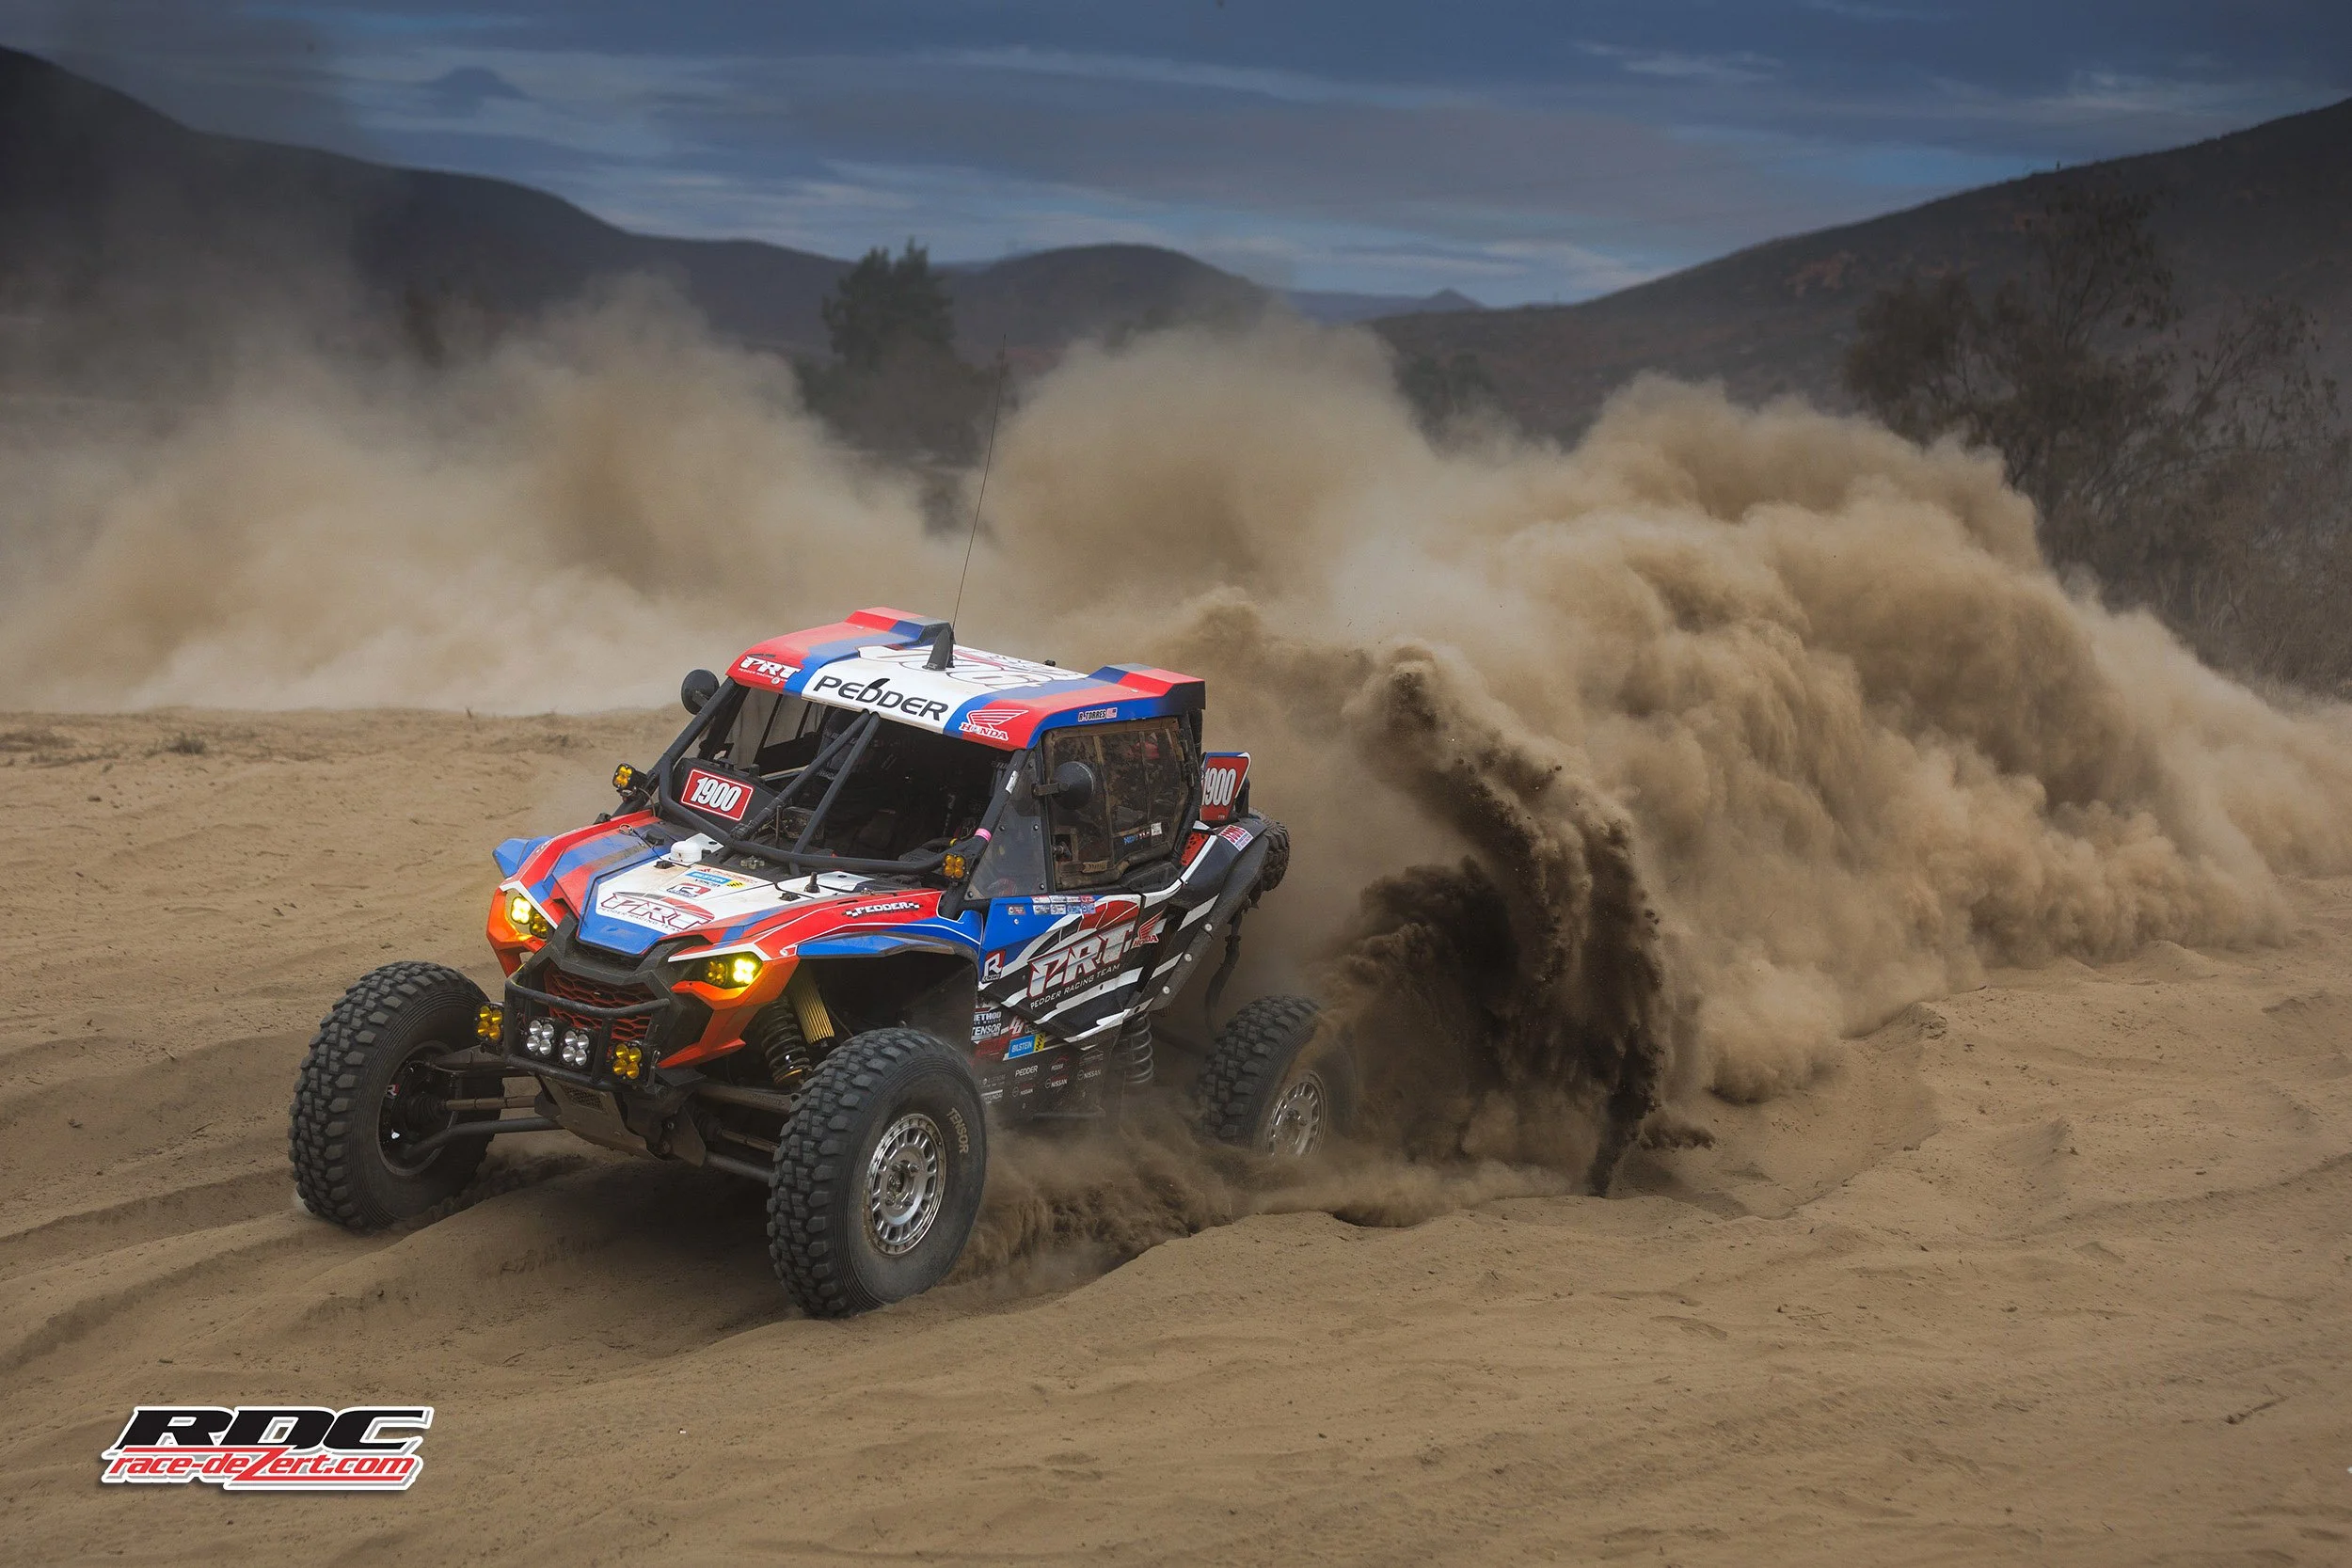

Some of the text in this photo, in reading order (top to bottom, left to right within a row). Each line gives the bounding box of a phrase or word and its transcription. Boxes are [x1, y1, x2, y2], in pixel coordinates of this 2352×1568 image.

[739, 656, 803, 679] PRT
[813, 675, 948, 721] PEDDER
[960, 722, 1009, 740] HONDA
[691, 777, 742, 812] 1900
[1202, 768, 1237, 806] 1900
[600, 893, 712, 930] PRT
[854, 901, 911, 915] PEDDER
[1026, 920, 1136, 998] PRT
[1030, 963, 1120, 1011] PEDDER RACING TEAM
[1011, 1040, 1032, 1053] BILSTEIN
[1015, 1065, 1038, 1078] PEDDER
[946, 1107, 969, 1153] TENSOR
